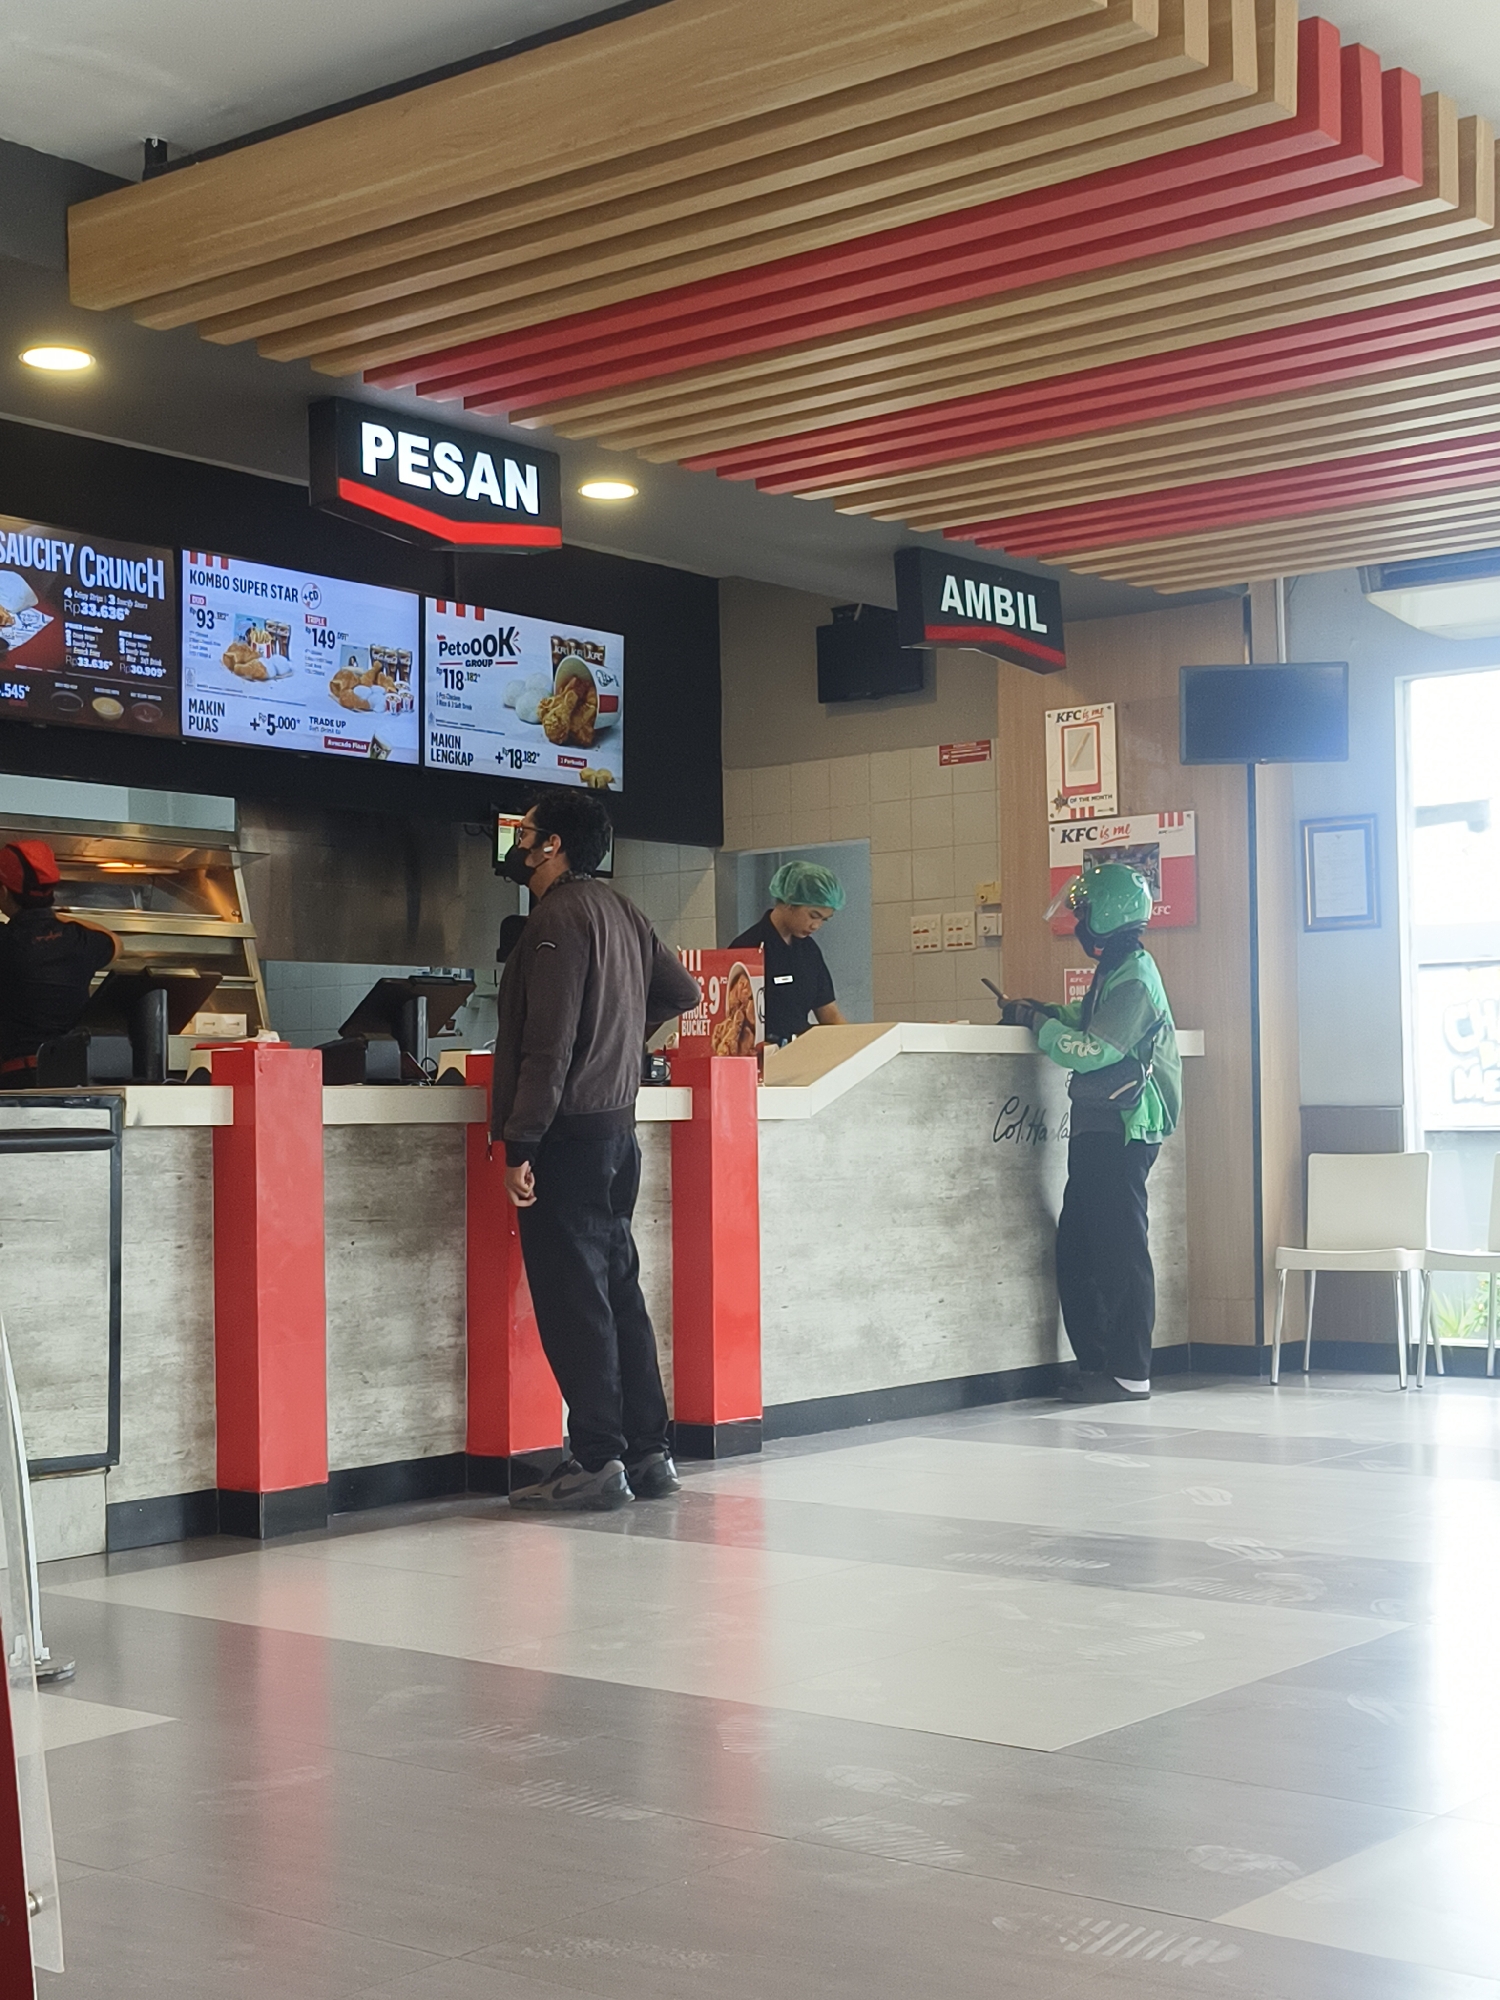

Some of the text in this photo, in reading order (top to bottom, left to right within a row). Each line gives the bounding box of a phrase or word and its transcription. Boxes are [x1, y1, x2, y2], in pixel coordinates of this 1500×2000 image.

[361, 421, 539, 515] PESAN
[80, 545, 165, 600] CRUNCH
[189, 569, 299, 603] KOMBO SUPER STAR
[64, 587, 73, 598] 4
[108, 594, 116, 605] 3
[940, 574, 1048, 634] AMBIL
[465, 659, 493, 667] GROUP
[188, 698, 226, 717] MAKIN
[1056, 709, 1082, 724] KFC
[188, 715, 219, 733] PUAS
[309, 716, 346, 729] TRADE UP
[430, 732, 461, 751] MAKIN
[430, 749, 474, 767] LENGKAP
[1060, 823, 1131, 844] KFC is me
[708, 976, 720, 1015] 9
[681, 1020, 711, 1037] BUCKET
[1057, 1034, 1102, 1058] Grab
